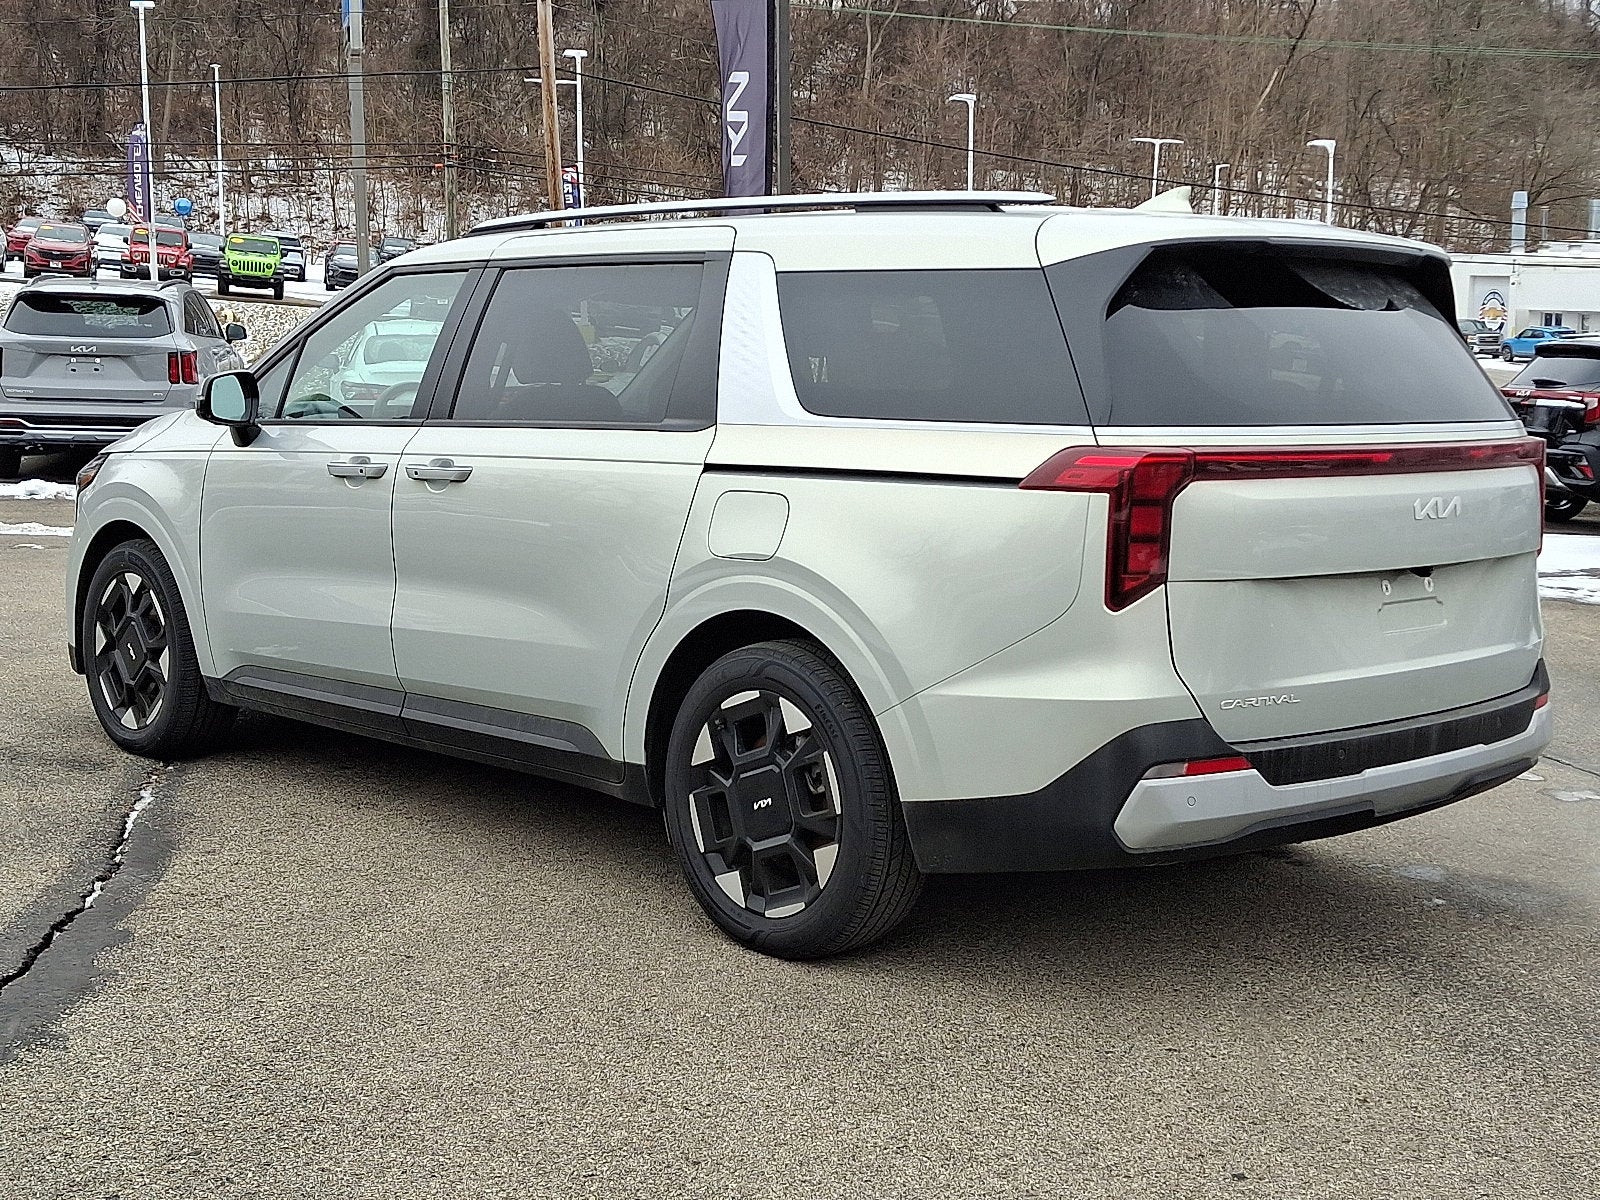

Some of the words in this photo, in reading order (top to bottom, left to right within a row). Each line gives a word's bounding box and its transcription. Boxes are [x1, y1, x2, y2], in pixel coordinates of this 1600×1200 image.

[70, 345, 97, 353] KIA
[1413, 495, 1461, 520] KIA
[1219, 694, 1301, 710] CARNIVAL
